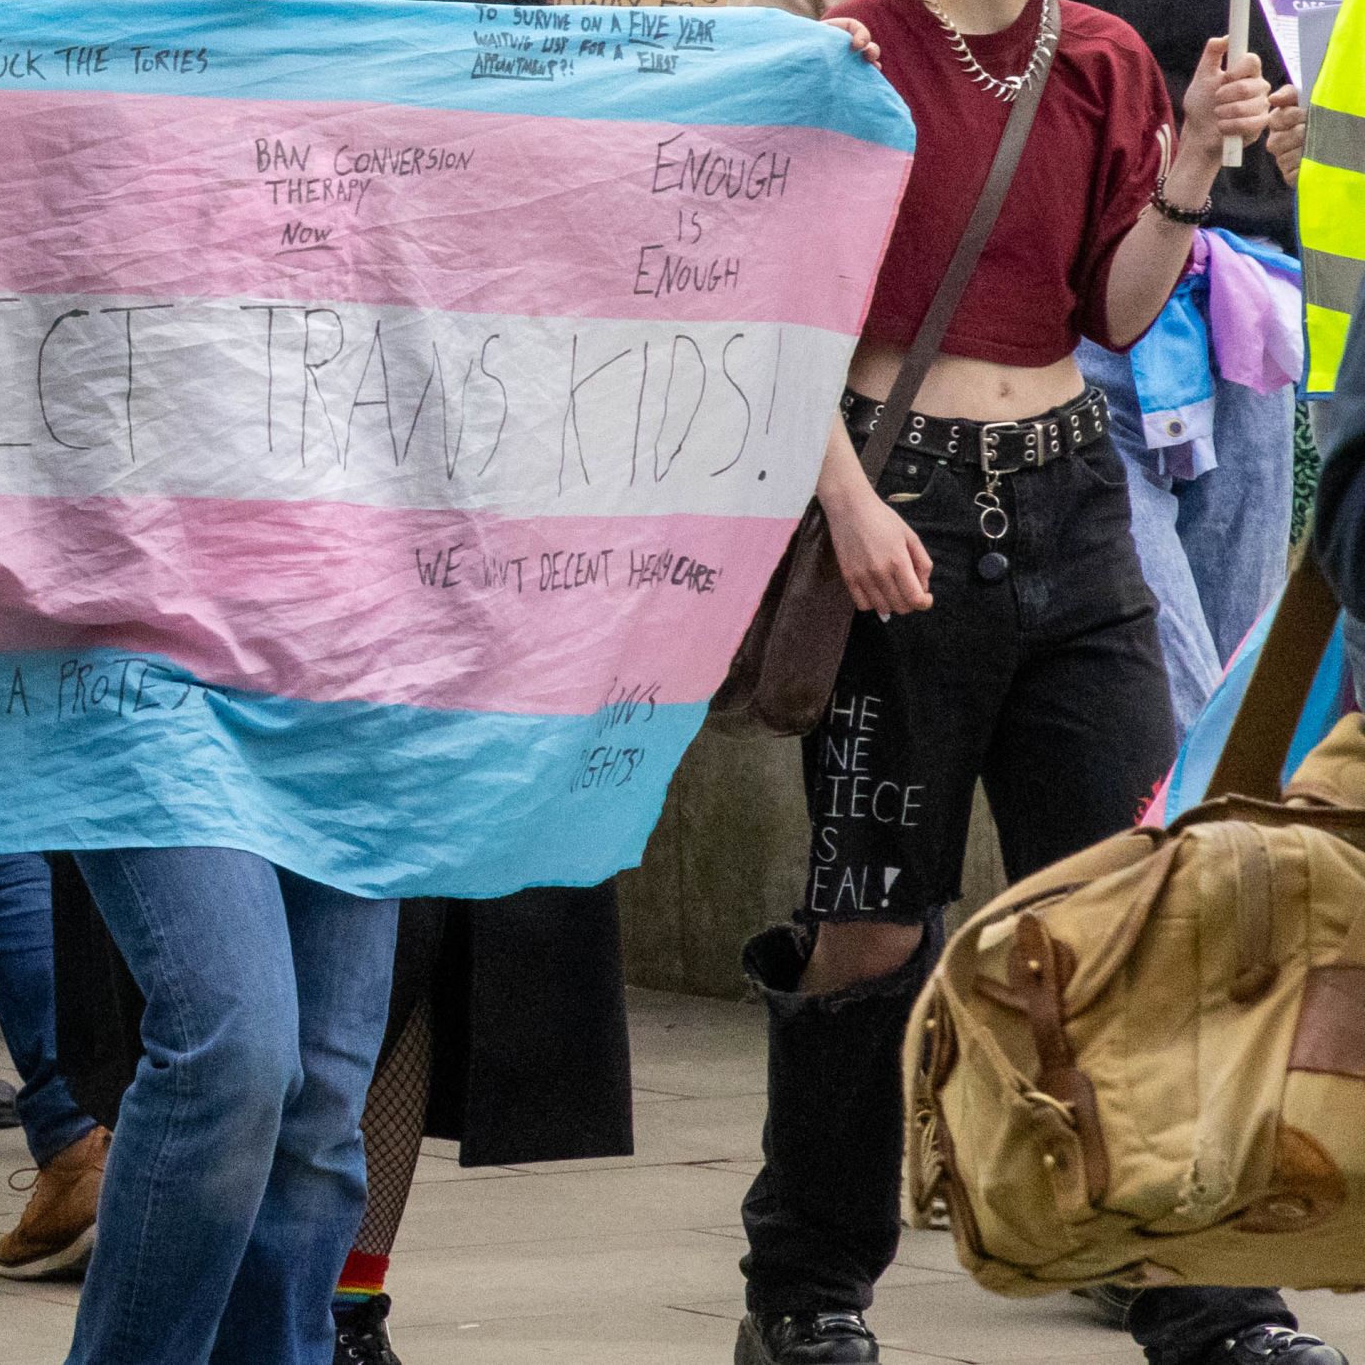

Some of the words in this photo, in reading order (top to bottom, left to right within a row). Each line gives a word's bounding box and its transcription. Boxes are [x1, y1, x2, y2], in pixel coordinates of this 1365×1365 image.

[474, 4, 498, 23] TO
[581, 16, 602, 33] ON
[610, 13, 622, 33] A
[629, 11, 669, 40] FIVE
[54, 45, 110, 76] THE
[255, 137, 310, 173] BAN
[334, 145, 475, 176] CONVERSION
[651, 132, 791, 201] ENOUGH
[266, 177, 371, 215] THERAPY
[281, 221, 332, 246] NOW
[676, 210, 703, 245] IS
[634, 245, 740, 298] ENOUGH
[240, 305, 509, 481] TRANS
[558, 327, 783, 498] KIDS!
[415, 543, 465, 589] WE
[540, 549, 614, 592] DECENT
[6, 667, 30, 717] A
